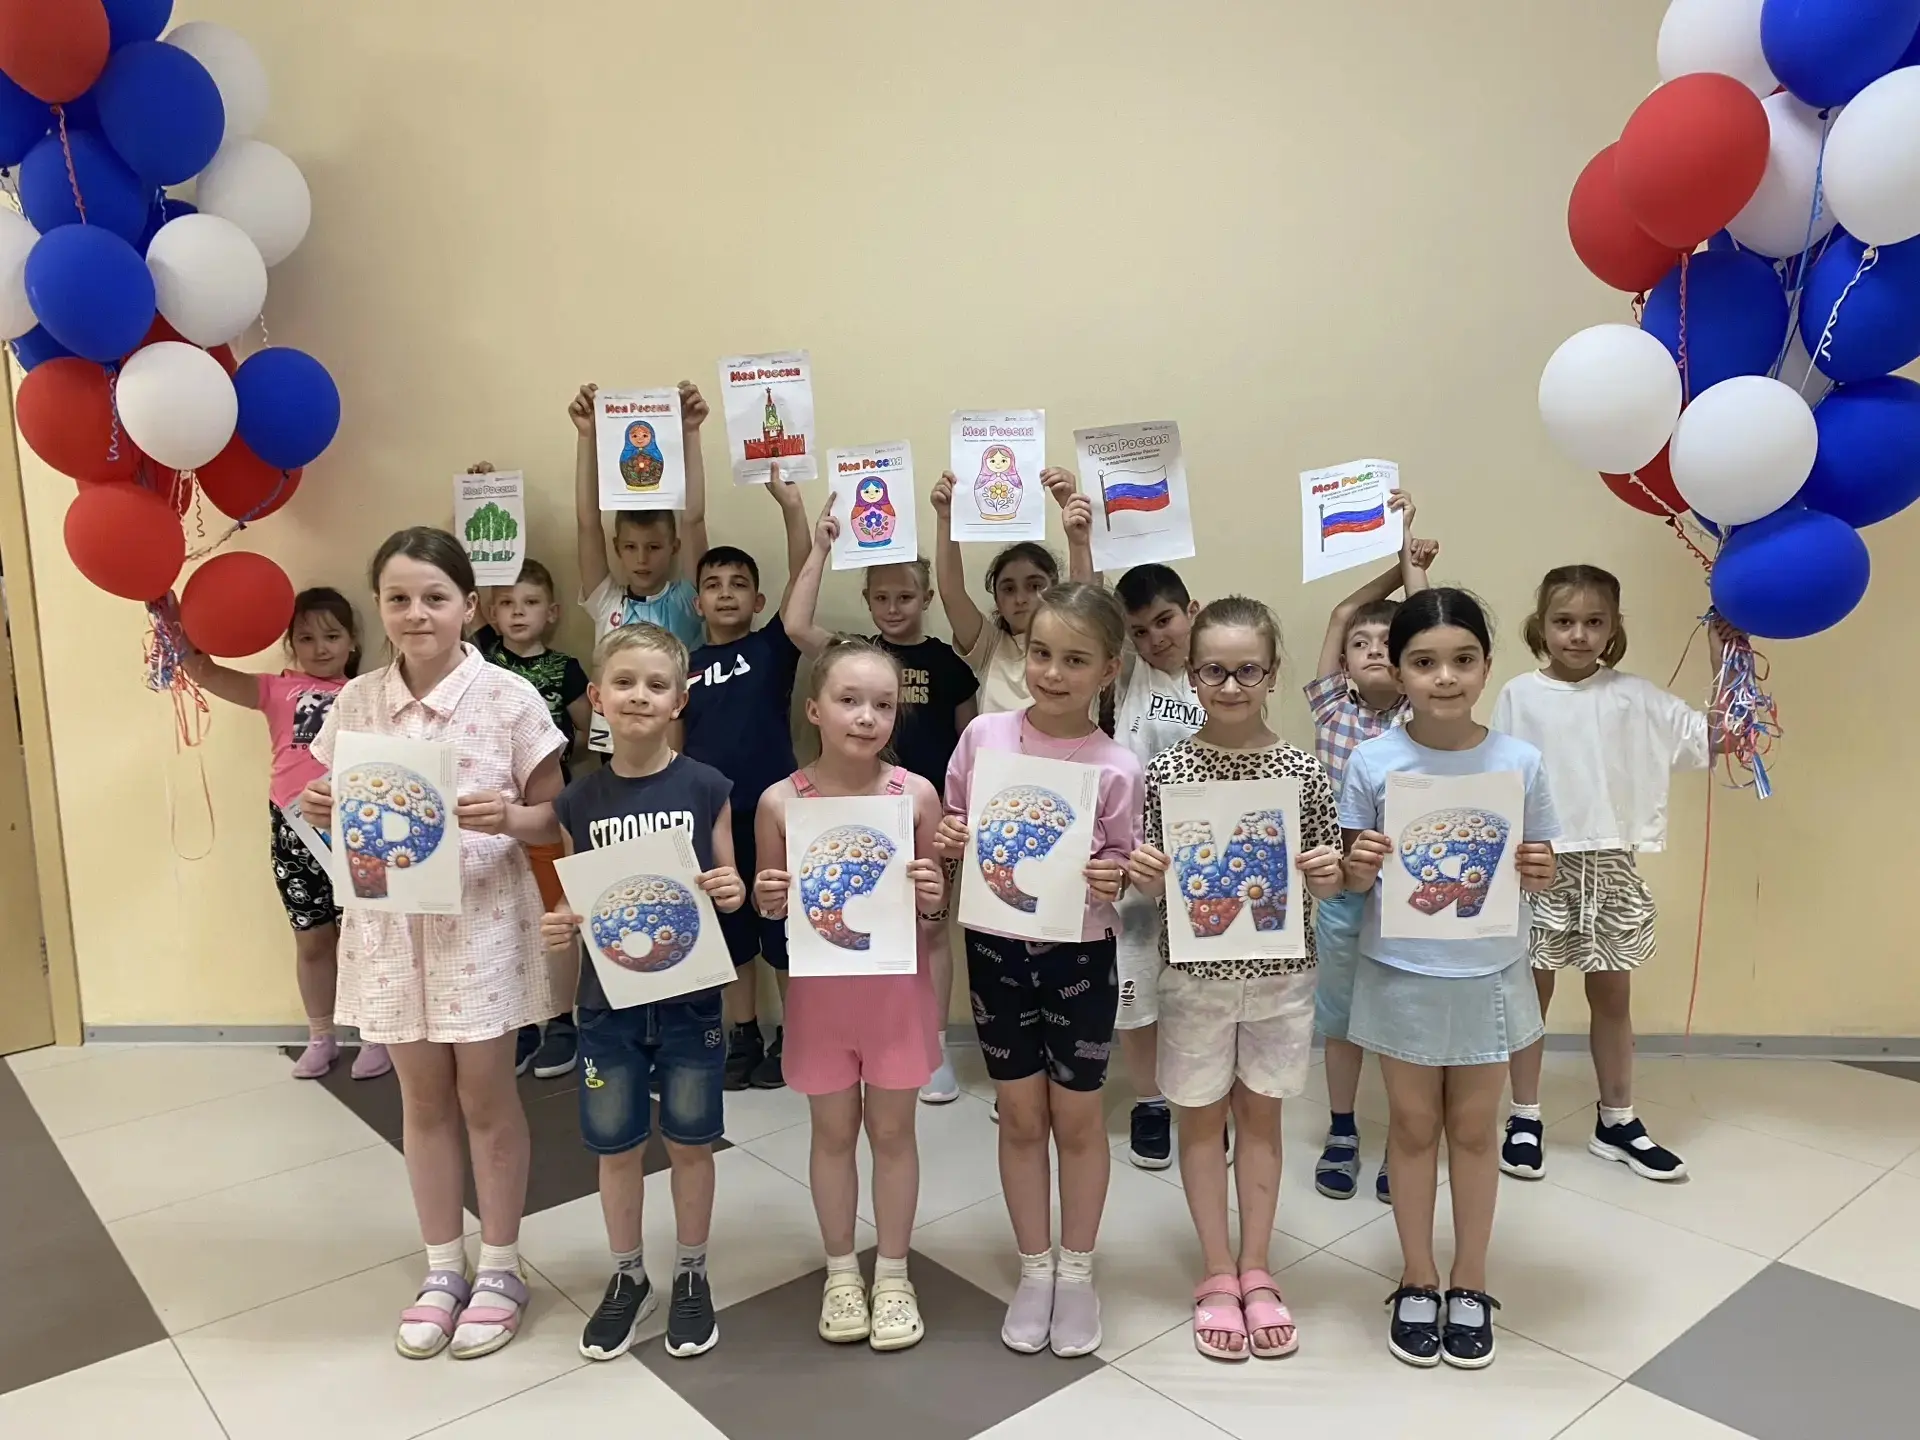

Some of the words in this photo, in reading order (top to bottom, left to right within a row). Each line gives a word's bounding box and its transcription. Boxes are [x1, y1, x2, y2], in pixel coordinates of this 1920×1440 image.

[730, 371, 755, 382] Моя
[757, 368, 800, 379] Россия
[605, 404, 628, 413] Моя
[962, 426, 987, 436] Моя
[989, 425, 1034, 436] Россия
[1088, 443, 1117, 456] Моя
[1118, 434, 1170, 451] Россия
[838, 462, 860, 473] Моя
[862, 457, 903, 469] Россия
[1312, 481, 1339, 495] Моя
[1341, 471, 1390, 487] Россия
[901, 668, 929, 685] EPIC
[1397, 807, 1513, 918] Я
[1058, 979, 1091, 1000] MOOD
[476, 1277, 505, 1289] FILA
